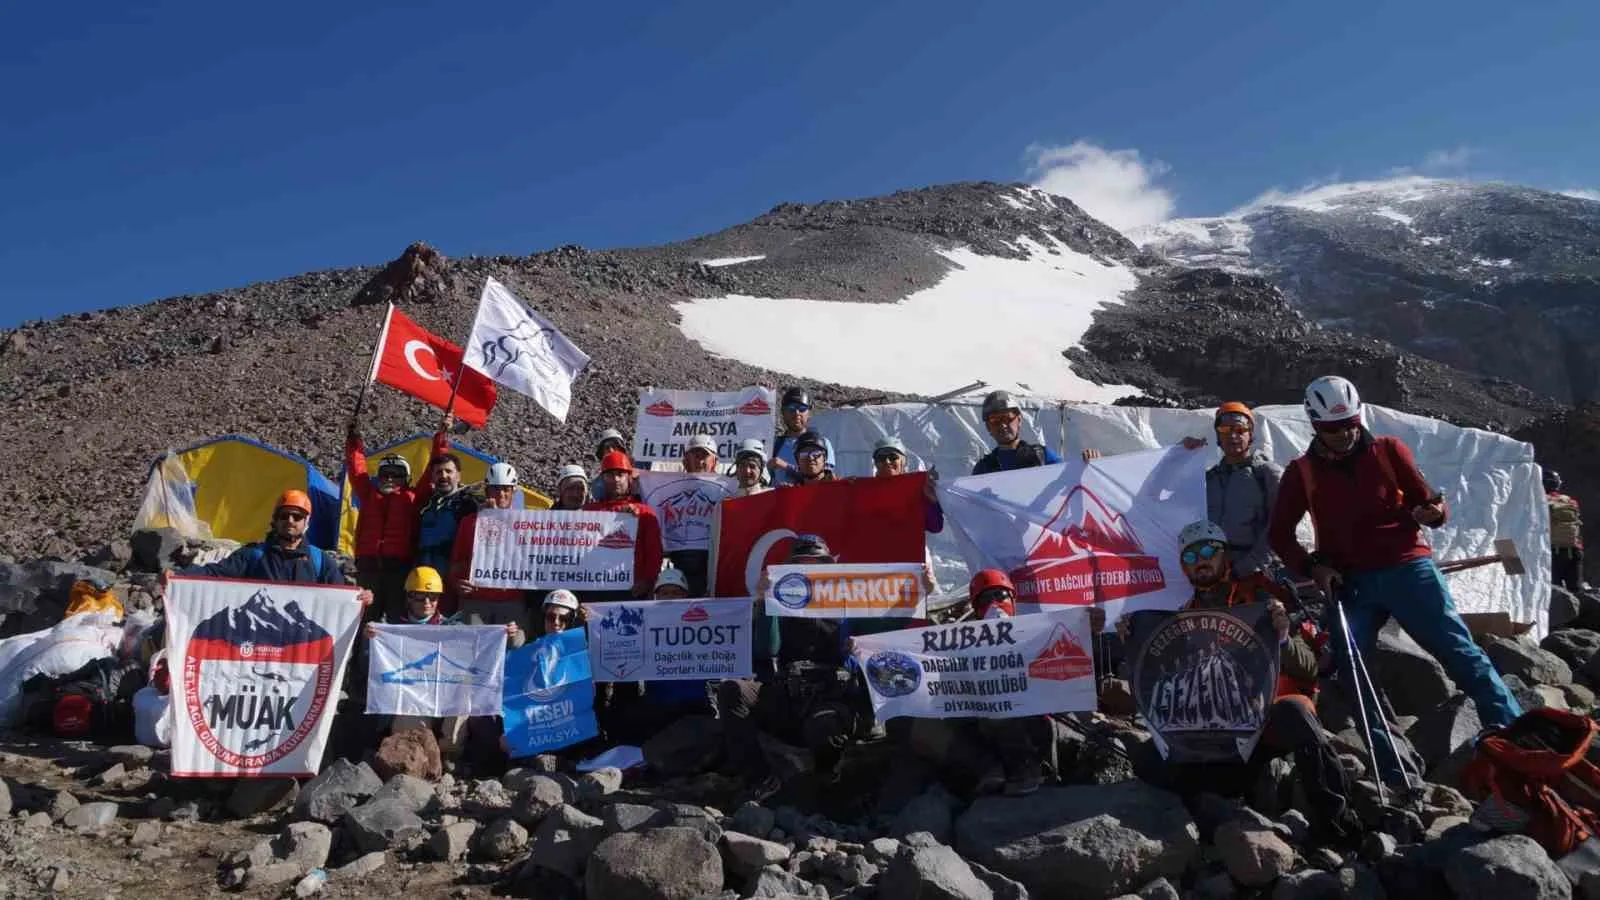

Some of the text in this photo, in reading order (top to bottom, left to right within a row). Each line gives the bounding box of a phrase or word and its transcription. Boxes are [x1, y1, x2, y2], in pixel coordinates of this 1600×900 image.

[672, 421, 738, 437] AMASYA
[642, 438, 657, 457] İL
[512, 519, 601, 532] GENÇLİK VE SPOR
[528, 552, 581, 566] TUNCELİ
[474, 567, 630, 583] DAĞCILIK İL TEMSİLCİLİĞİ
[1054, 572, 1094, 592] DAĞCILIK
[1095, 569, 1163, 587] FEDERASYONU
[814, 577, 914, 602] MARKUT
[650, 624, 741, 646] TUDOST
[921, 621, 1017, 652] RUBAR
[654, 650, 693, 663] Dağcılık
[696, 652, 709, 660] ve
[712, 650, 737, 662] Doğa
[921, 655, 969, 673] DAĞCILIK
[972, 656, 986, 672] VE
[990, 650, 1025, 671] DOĞA
[656, 663, 735, 677] Sporları Kulübü
[927, 672, 1028, 697] SPORLARI KULÜBÜ
[210, 684, 298, 731] MÜAK
